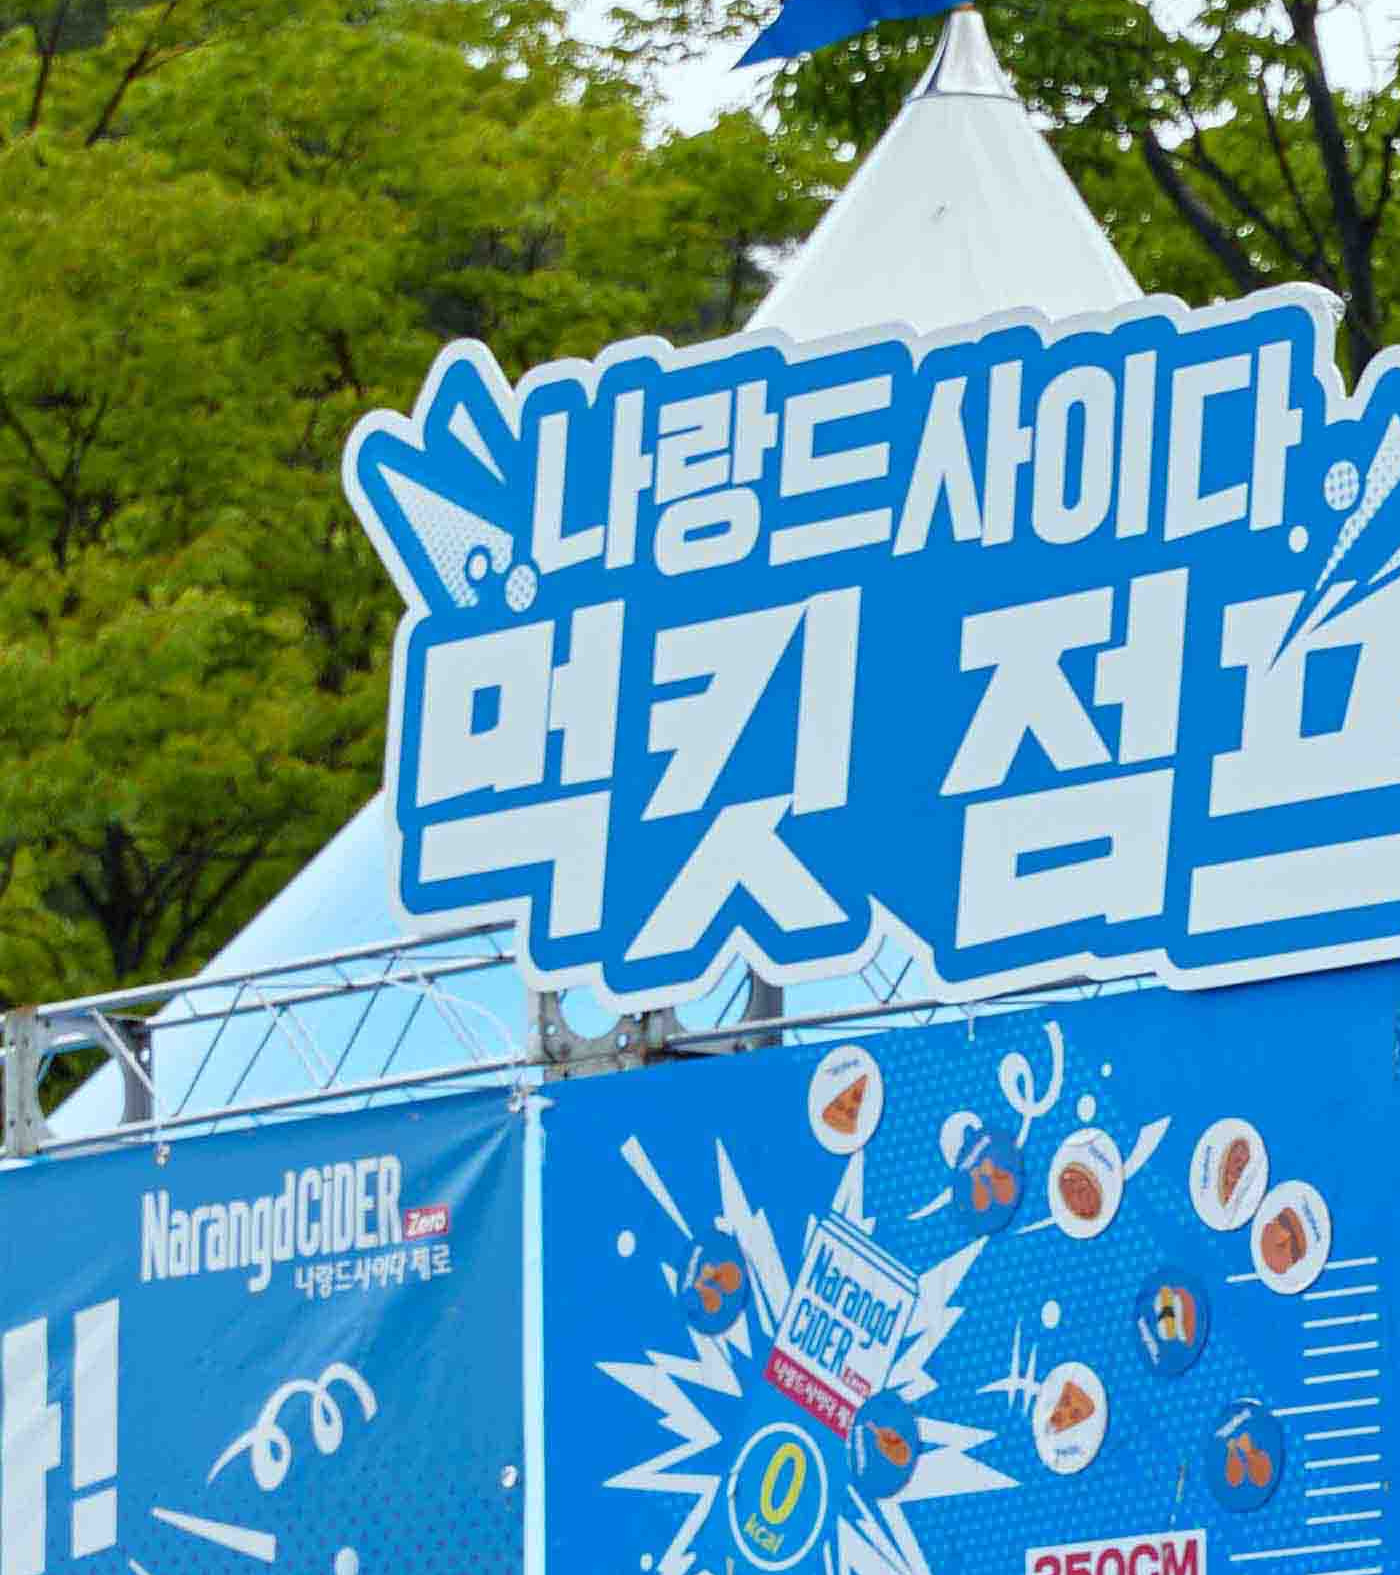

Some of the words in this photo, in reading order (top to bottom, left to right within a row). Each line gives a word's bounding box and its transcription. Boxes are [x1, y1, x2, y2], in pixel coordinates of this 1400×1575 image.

[534, 340, 1303, 577] 나랑드사이다
[415, 586, 862, 962] 먹킷
[411, 1244, 453, 1281] 제로
[759, 1442, 806, 1524] 0
